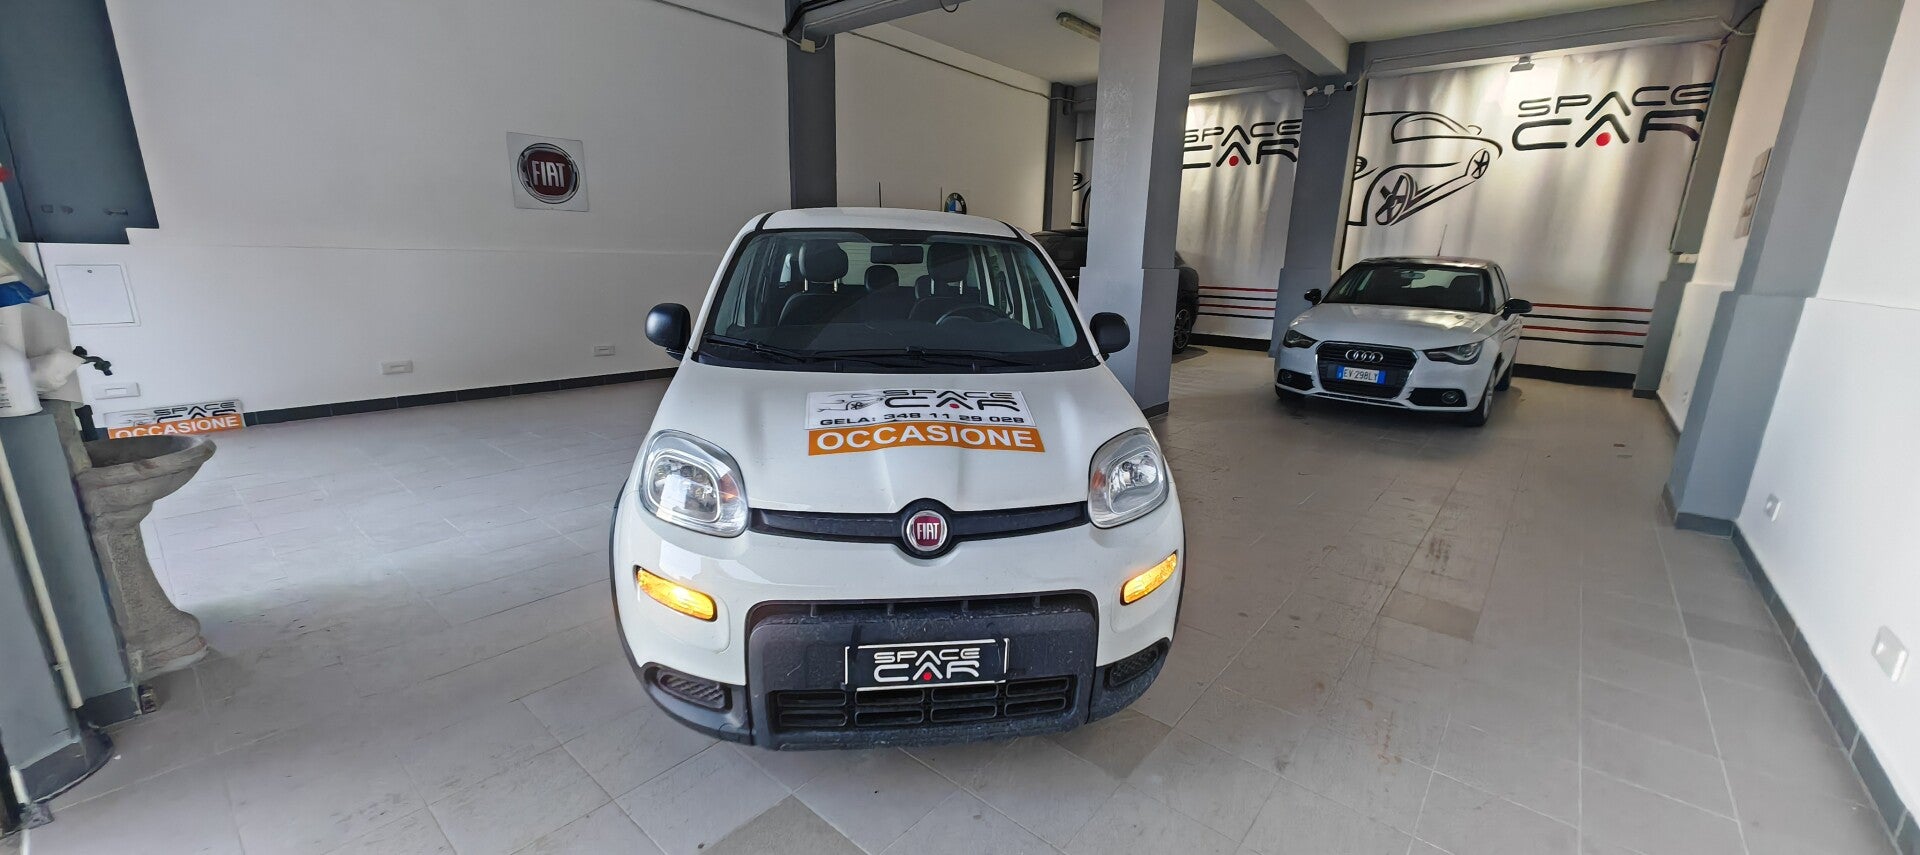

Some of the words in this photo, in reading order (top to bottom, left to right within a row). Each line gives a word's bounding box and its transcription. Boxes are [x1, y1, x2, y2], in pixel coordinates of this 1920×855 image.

[1518, 82, 1713, 120] SPACE
[1184, 119, 1302, 146] SPACE
[1512, 109, 1704, 151] CAR
[531, 160, 565, 188] FIAT
[882, 390, 1015, 400] SPACE
[884, 397, 1020, 412] CAR
[153, 401, 236, 416] SPACE
[820, 417, 876, 426] GELA:
[959, 414, 982, 422] 29
[115, 416, 240, 439] OCCASIONE
[817, 425, 1036, 450] OCCASIONE
[916, 522, 939, 540] FIAT
[873, 647, 981, 666] SPACE
[873, 660, 980, 683] CAR
